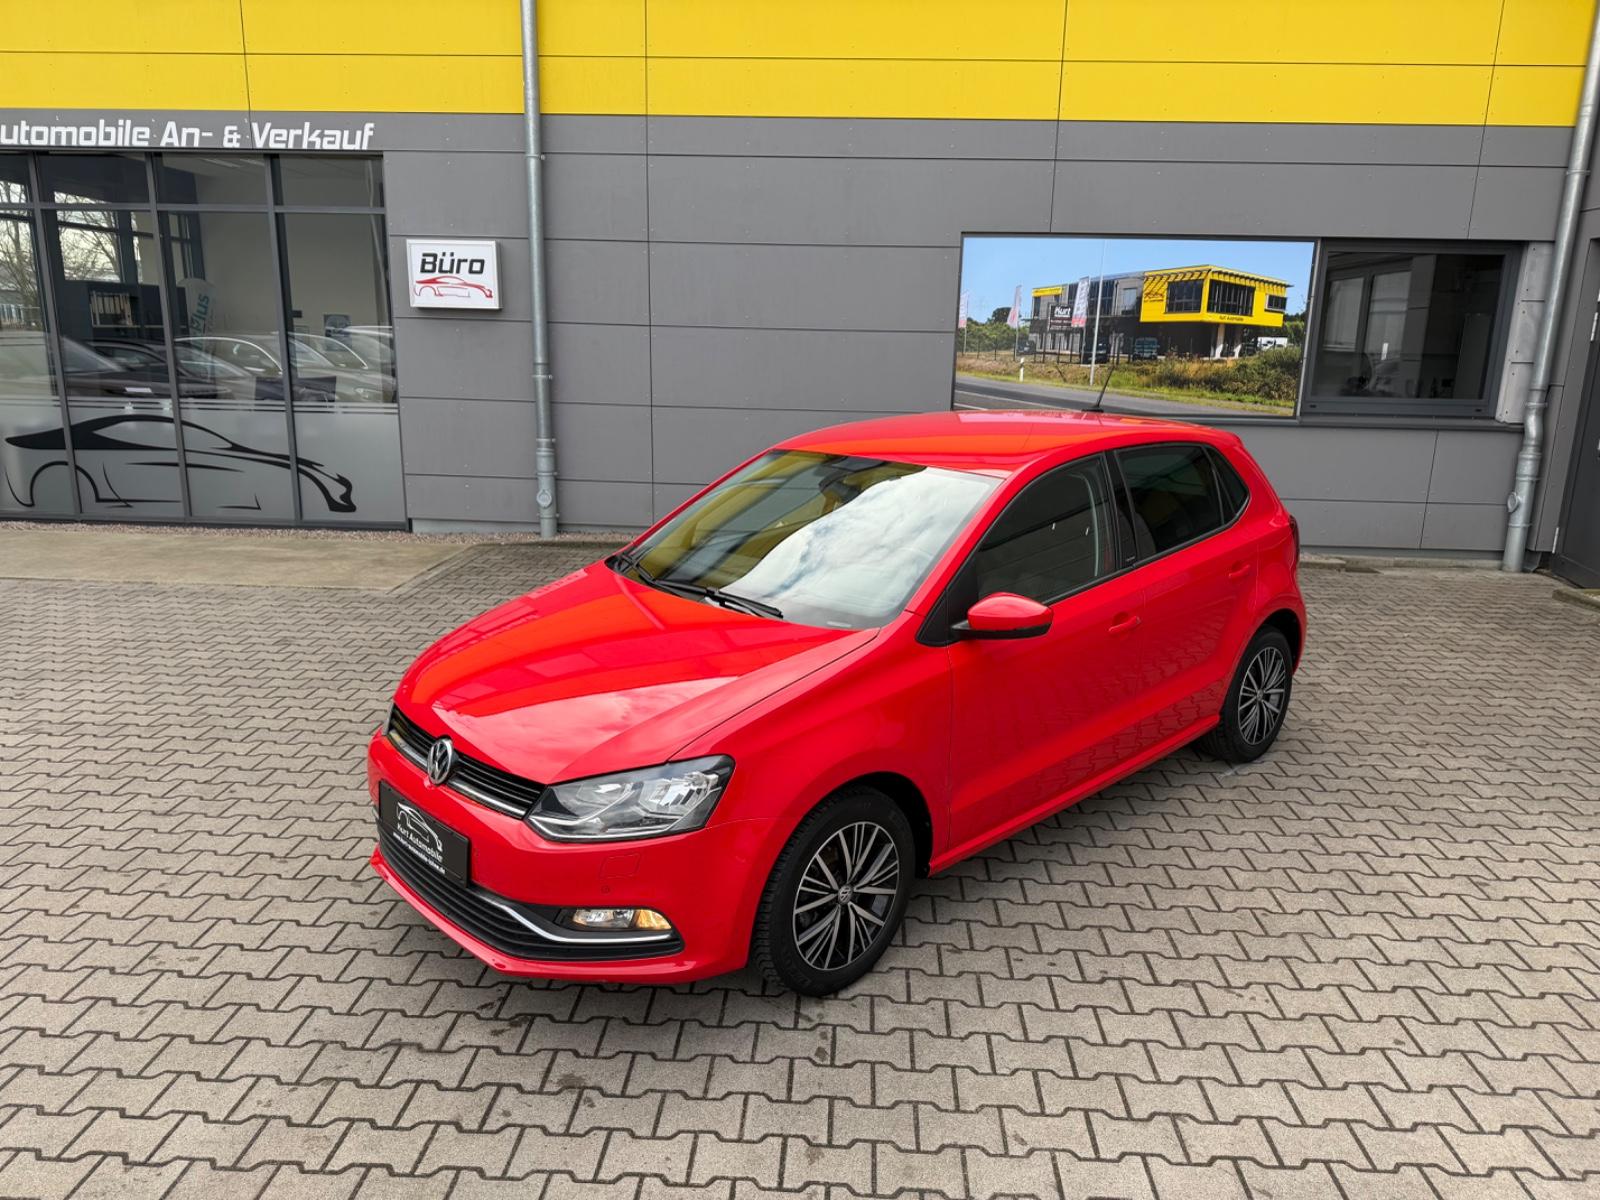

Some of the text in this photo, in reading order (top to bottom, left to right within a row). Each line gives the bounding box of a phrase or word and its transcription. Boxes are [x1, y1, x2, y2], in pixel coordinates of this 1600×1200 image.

[160, 120, 213, 148] An-
[222, 125, 241, 148] &
[252, 122, 375, 150] Verkauf
[420, 251, 485, 274] Büro
